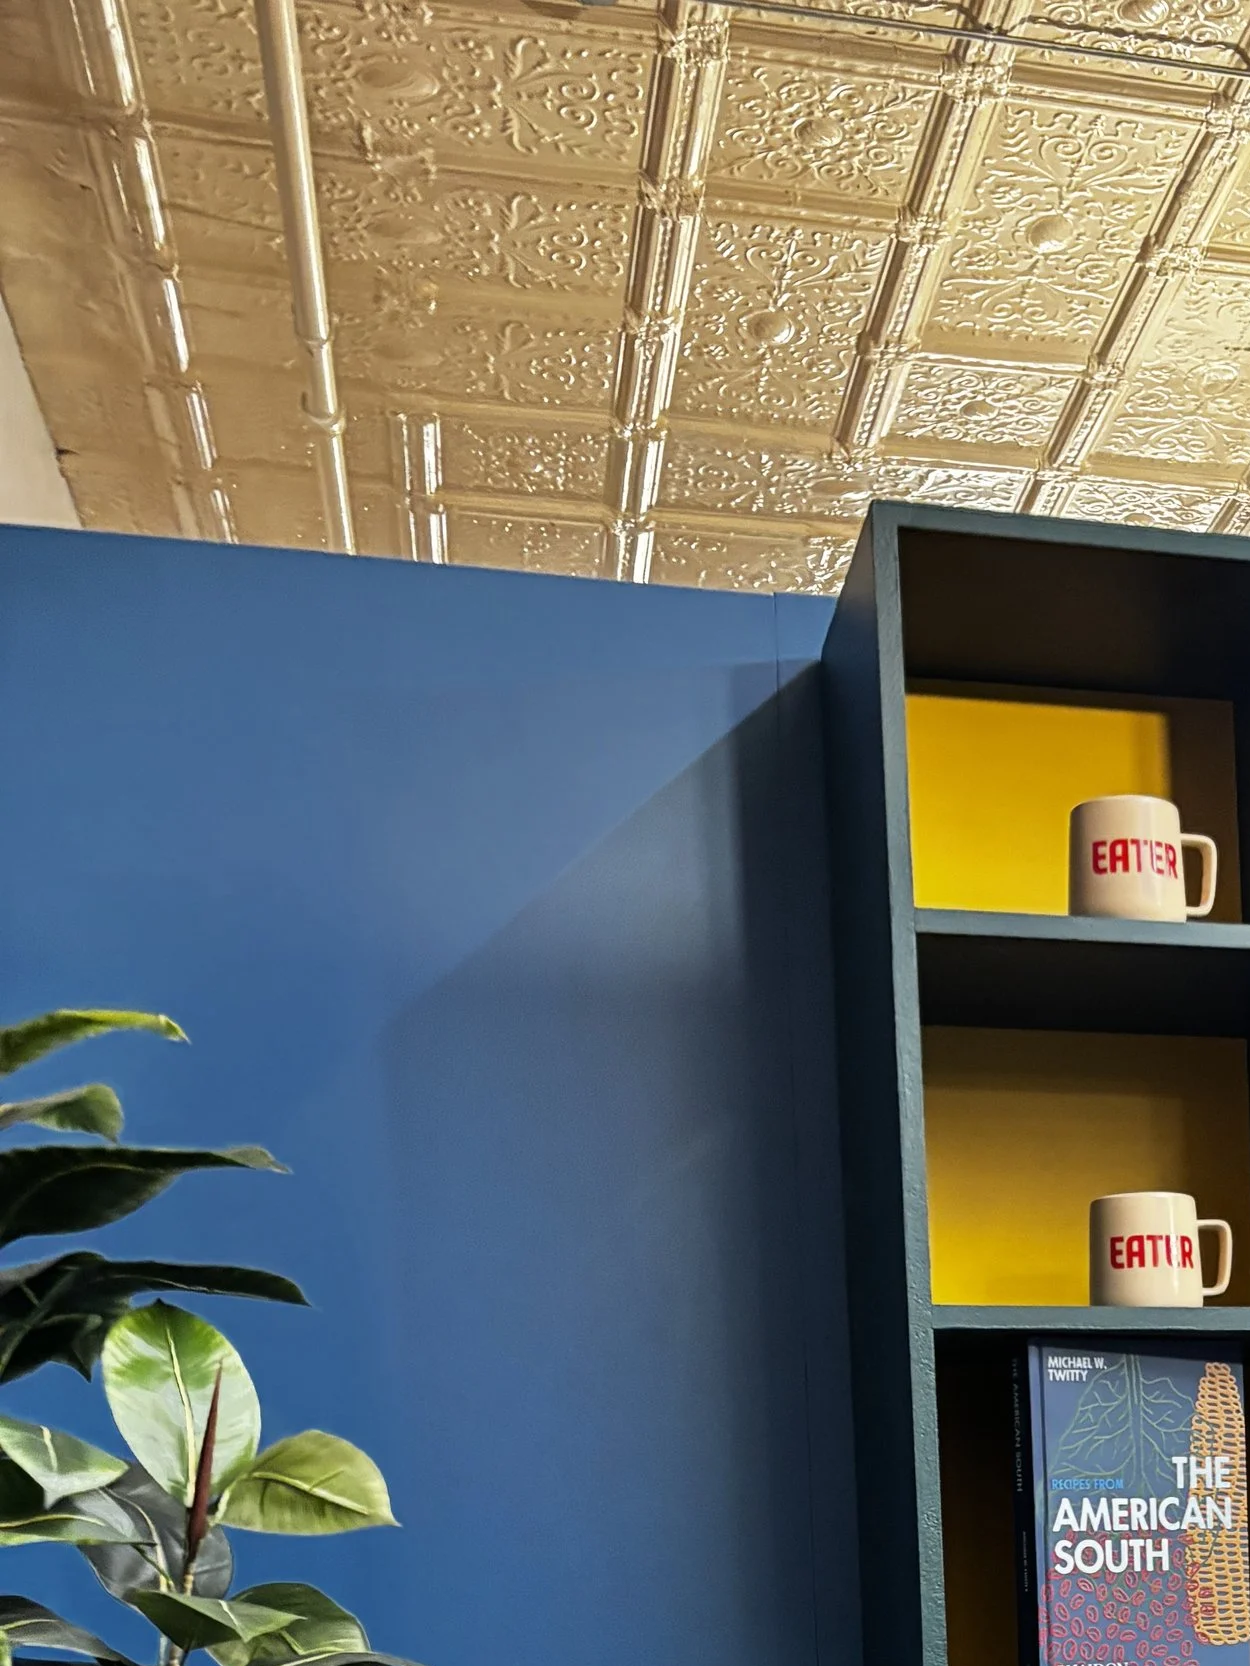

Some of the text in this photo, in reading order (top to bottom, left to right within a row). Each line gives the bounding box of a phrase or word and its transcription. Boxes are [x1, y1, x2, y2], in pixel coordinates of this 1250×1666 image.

[1092, 838, 1178, 879] EATER
[1047, 1356, 1107, 1370] MICHAEL W.
[1048, 1369, 1088, 1382] TWITTY
[1052, 1478, 1125, 1490] RECIPES FROM
[1172, 1456, 1232, 1489] THE
[1052, 1497, 1233, 1532] AMERICAN
[1054, 1538, 1170, 1575] SOUTH
